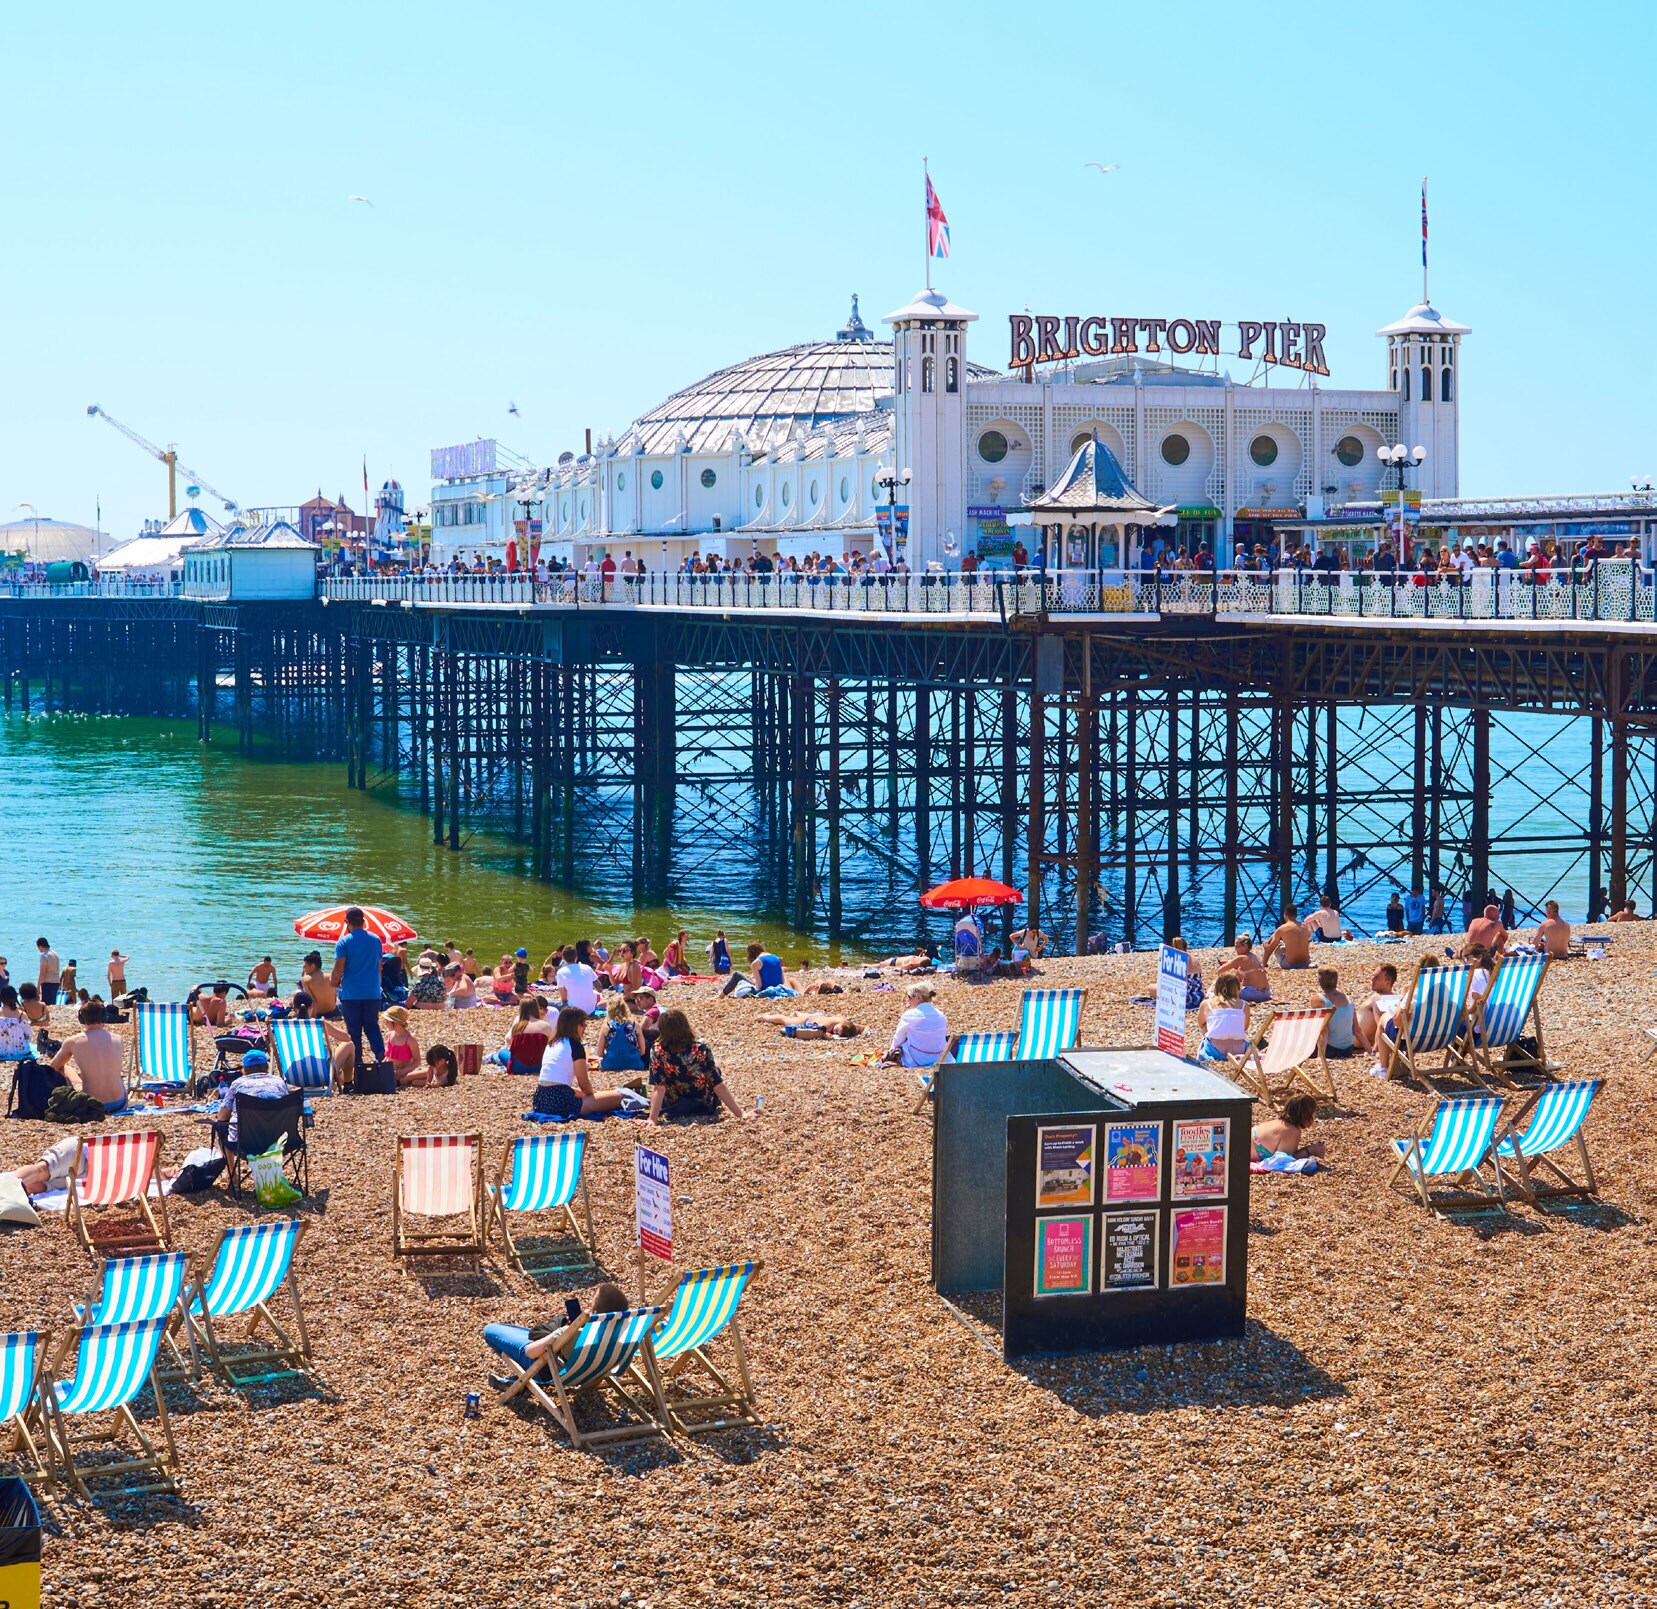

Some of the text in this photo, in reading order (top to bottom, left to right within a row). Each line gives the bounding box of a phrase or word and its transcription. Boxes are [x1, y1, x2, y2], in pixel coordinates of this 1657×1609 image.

[1008, 314, 1331, 377] BRIGHTON PIER
[1162, 949, 1187, 978] For Hire
[1180, 1126, 1211, 1136] foodies
[640, 1150, 669, 1182] For Hire
[1047, 1238, 1082, 1246] BOTTOMLESS
[1053, 1245, 1075, 1253] BRUNCH
